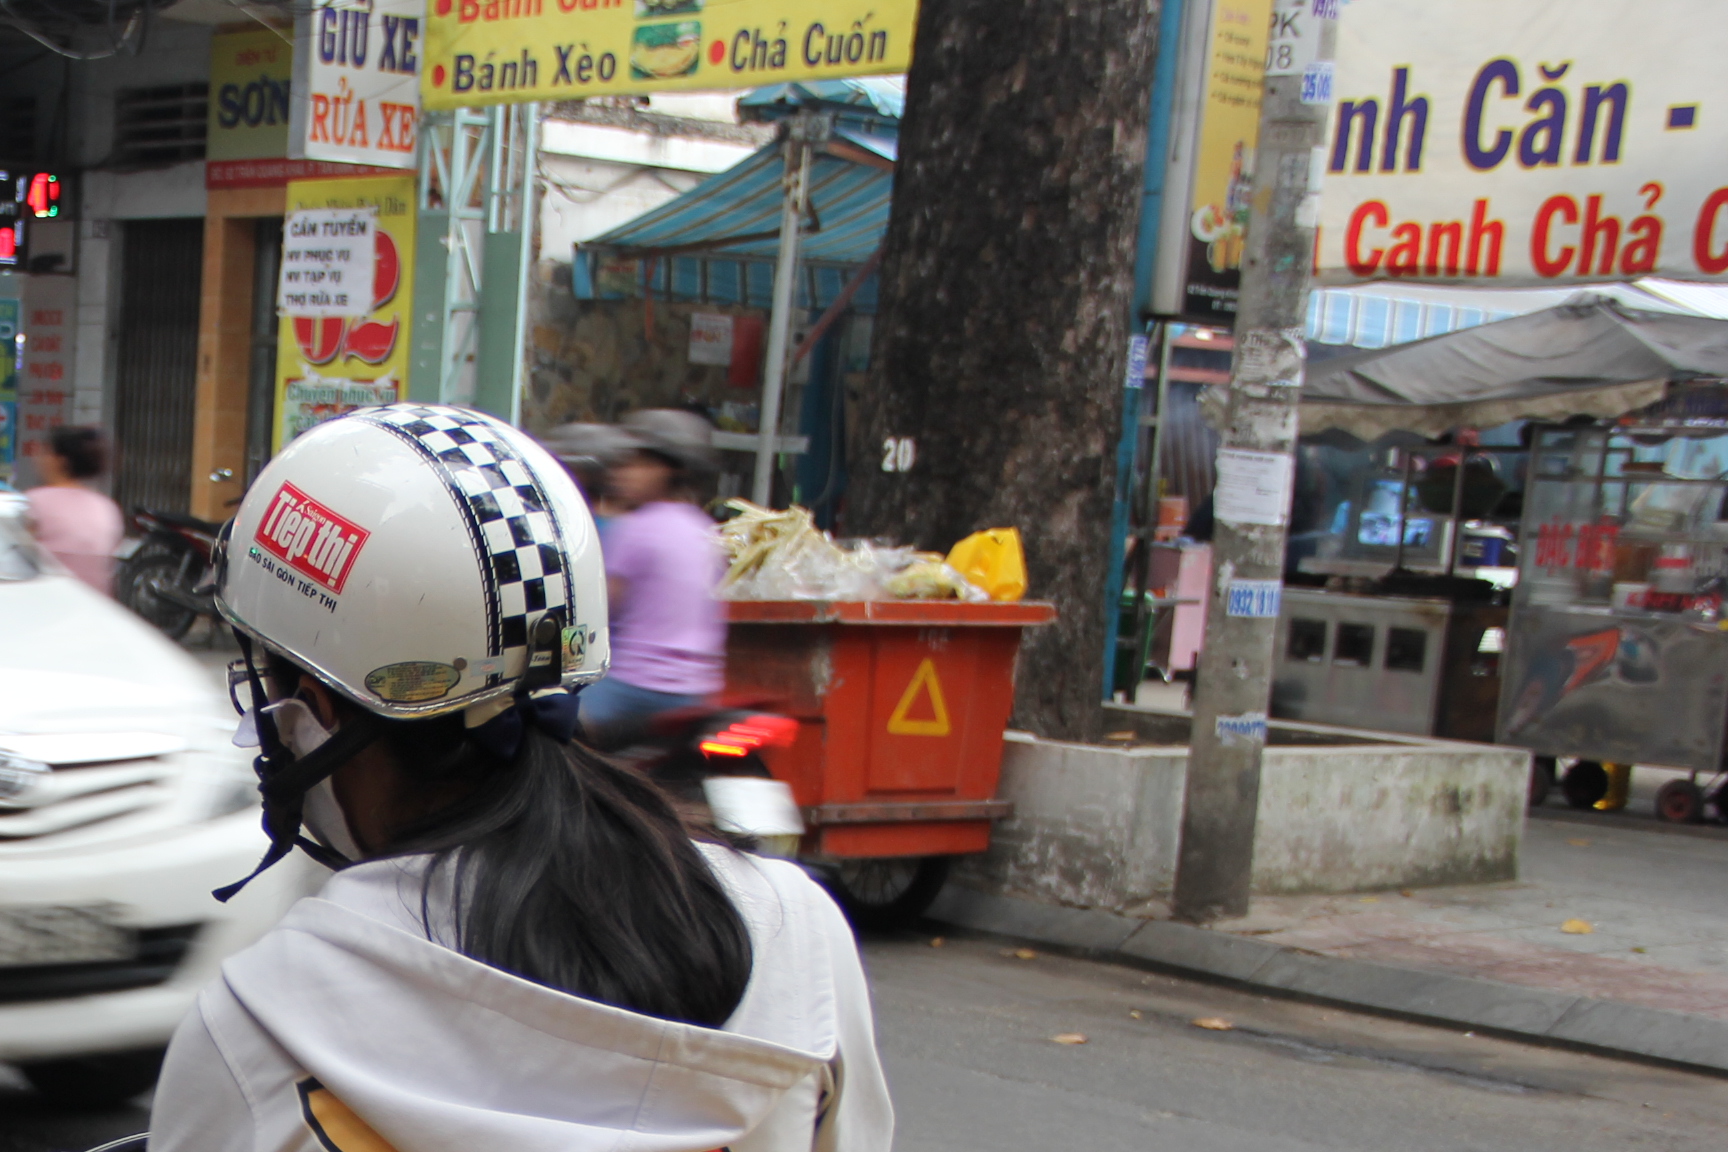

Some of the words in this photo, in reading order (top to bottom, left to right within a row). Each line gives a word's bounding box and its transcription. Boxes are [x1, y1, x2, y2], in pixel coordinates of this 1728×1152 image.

[379, 14, 419, 76] XE
[452, 53, 538, 93] Bánh
[552, 44, 616, 87] Xèo
[729, 21, 787, 72] Chả
[803, 13, 887, 65] Cuốn
[310, 76, 369, 148] RỬA
[376, 101, 417, 153] XE
[1460, 56, 1629, 172] Căn
[1343, 199, 1505, 279] Canh
[1530, 181, 1665, 279] Chả
[881, 436, 917, 473] 20
[262, 490, 318, 562] Tiếp
[306, 519, 359, 588] thị
[304, 504, 327, 525] Saigon
[262, 557, 275, 573] SÀI
[276, 564, 296, 588] GÒN
[297, 578, 318, 600] TIẾP
[319, 592, 339, 614] THỊ
